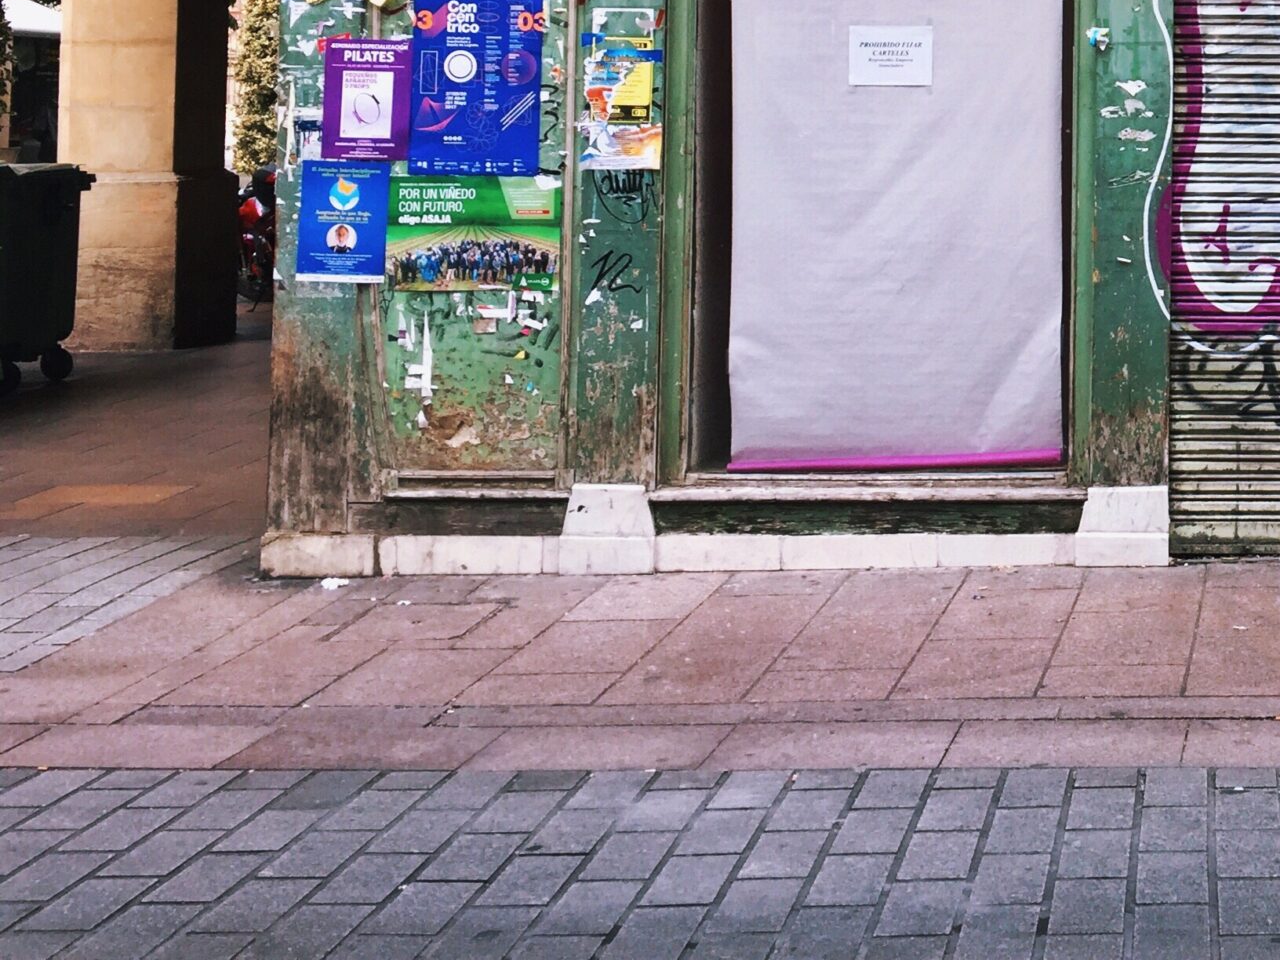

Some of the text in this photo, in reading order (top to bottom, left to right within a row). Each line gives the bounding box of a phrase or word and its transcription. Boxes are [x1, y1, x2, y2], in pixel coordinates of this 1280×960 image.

[343, 50, 395, 63] PILATES
[399, 186, 476, 200] POR UN VIÑEDO
[399, 201, 466, 214] CON FUTURO,
[398, 214, 452, 226] elige ASAJA
